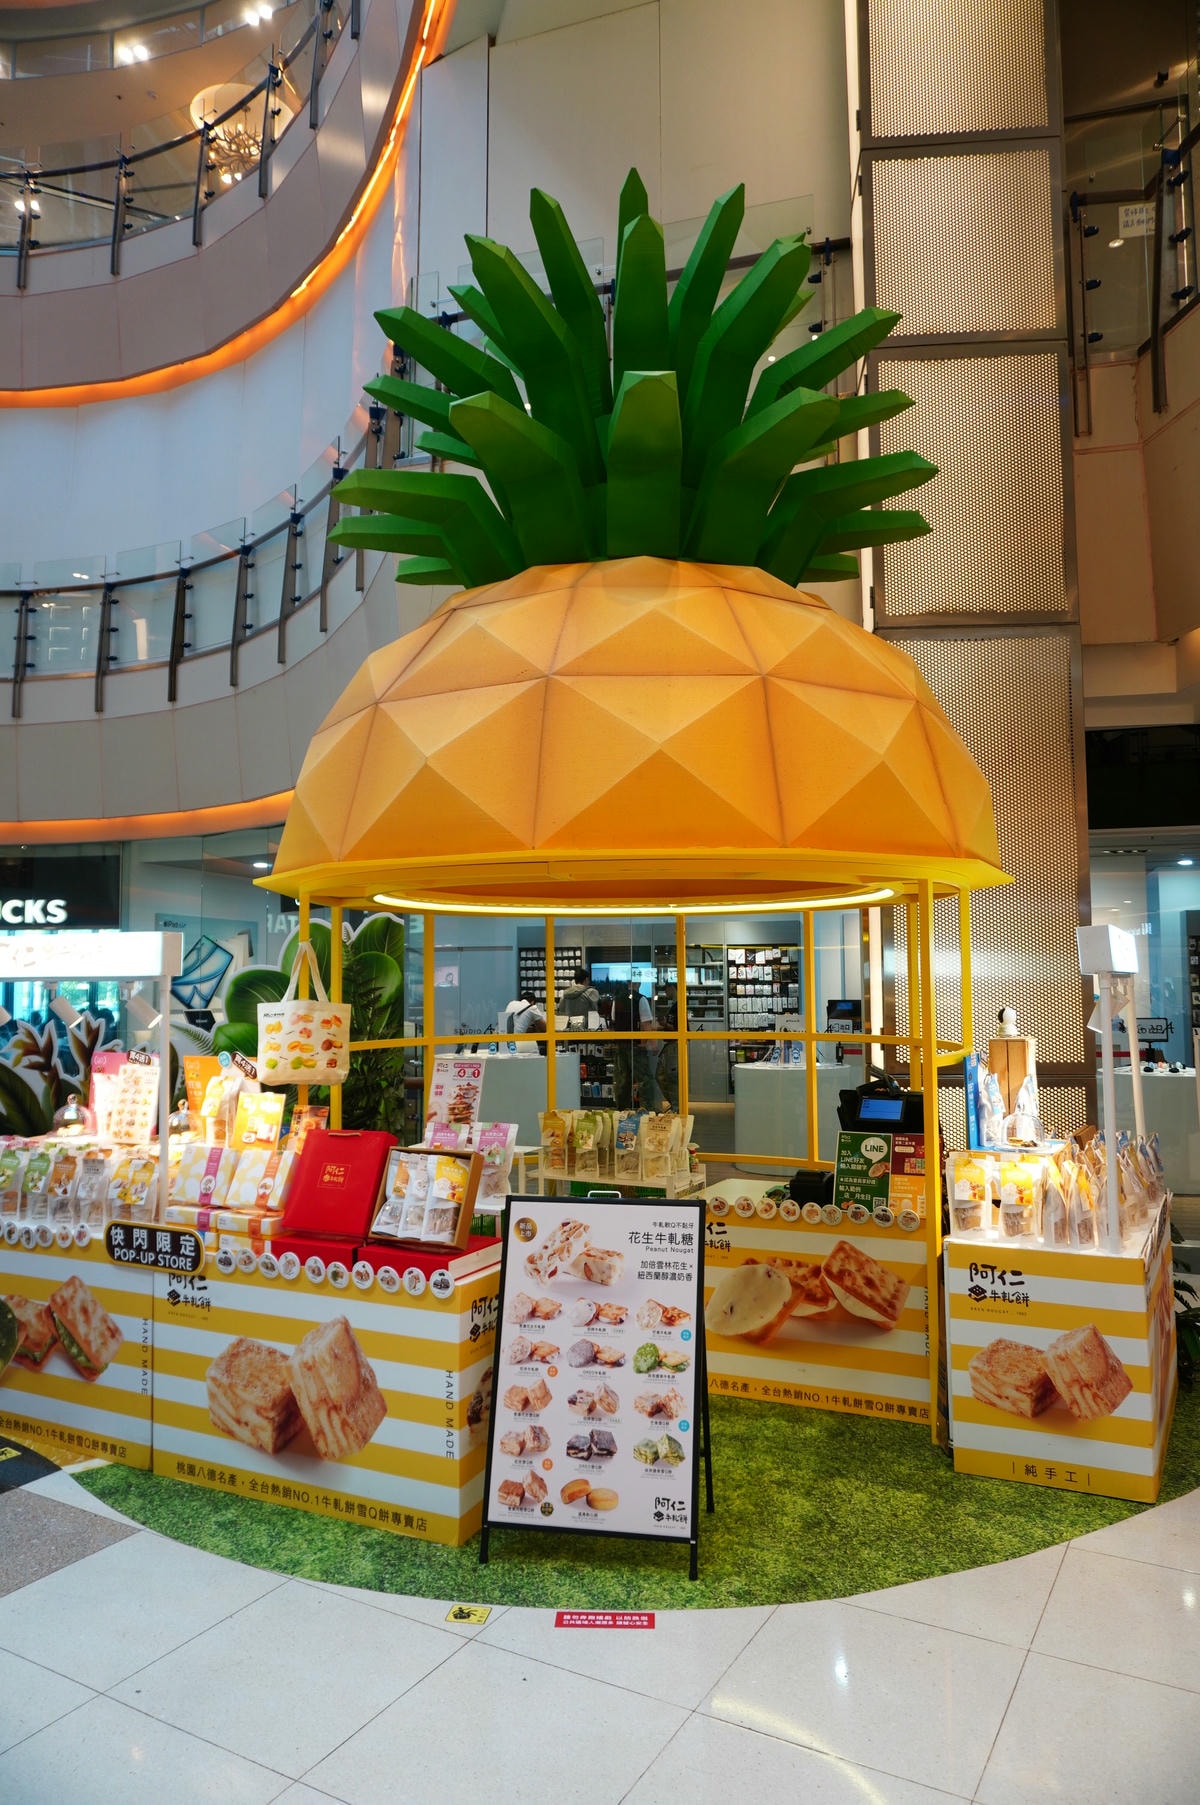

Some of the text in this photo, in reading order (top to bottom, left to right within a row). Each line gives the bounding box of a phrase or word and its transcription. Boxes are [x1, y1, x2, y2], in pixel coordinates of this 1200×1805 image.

[0, 899, 68, 924] CKS
[864, 1144, 885, 1153] LINE
[110, 1226, 196, 1257] 快閃限定
[628, 1231, 694, 1246] 花生牛軋糖
[114, 1247, 193, 1271] POP-UP STORE
[969, 1262, 1025, 1286] 阿仁
[989, 1289, 1031, 1307] 牛軋餅
[141, 1359, 149, 1395] MADE
[445, 1369, 455, 1460] HAND MADE
[1024, 1463, 1078, 1483] 純手工
[654, 1496, 686, 1511] 阿仁
[665, 1514, 688, 1524] 牛軋餅
